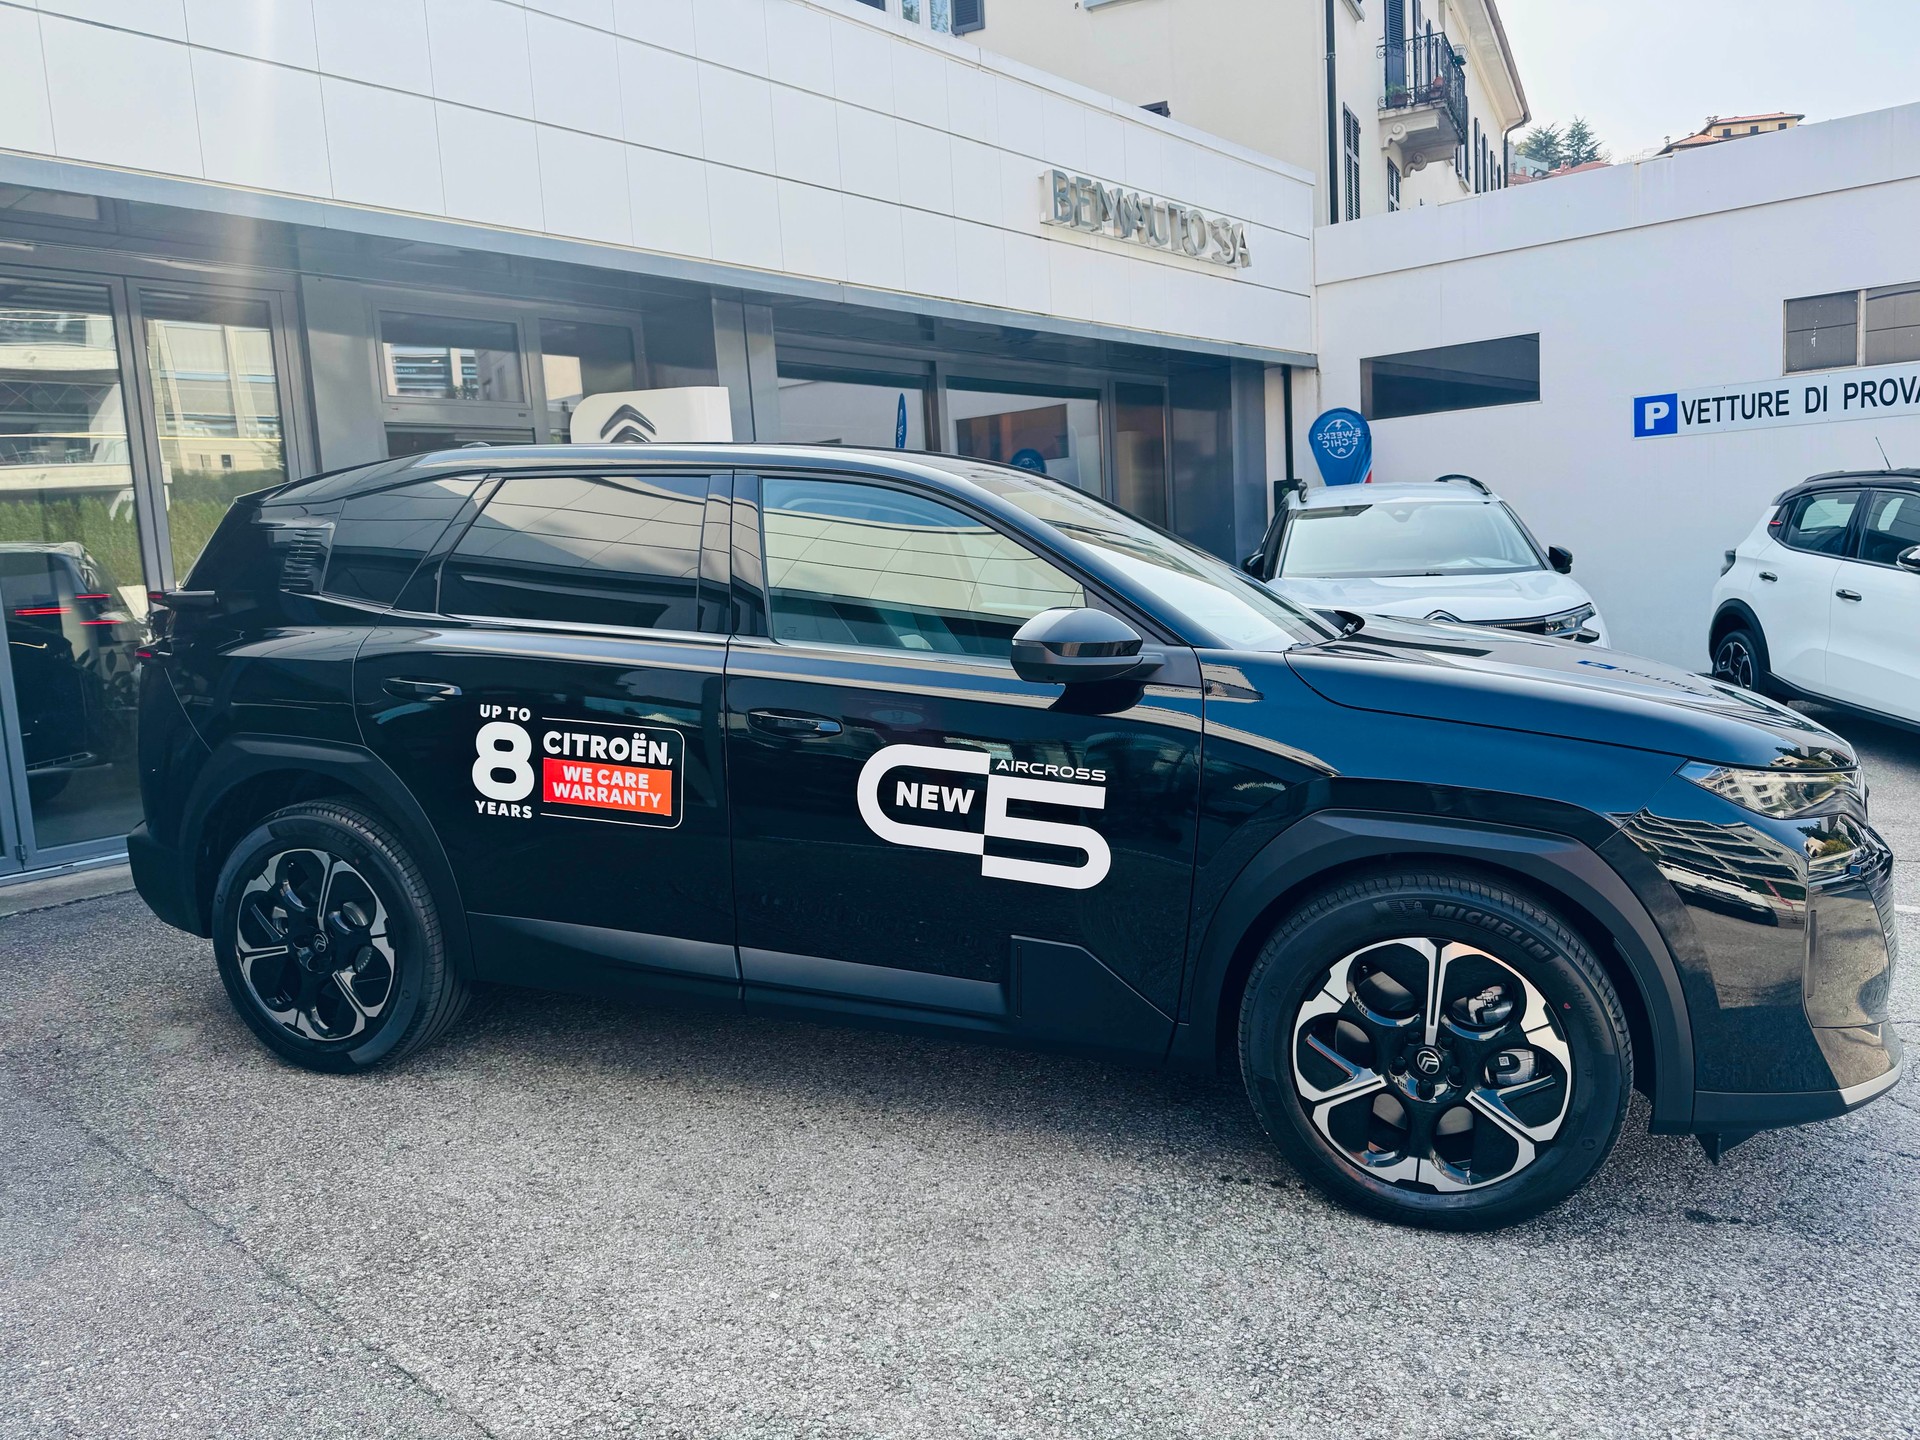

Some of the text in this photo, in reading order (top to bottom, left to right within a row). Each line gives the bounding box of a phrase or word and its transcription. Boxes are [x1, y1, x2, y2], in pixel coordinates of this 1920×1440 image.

[1644, 376, 1920, 431] P VETTURE DI PROV
[479, 703, 532, 722] UP TO
[472, 721, 535, 802] 8
[995, 759, 1107, 782] AIRCROSS
[563, 765, 650, 790] WE CARE
[552, 782, 662, 809] WARRANTY
[895, 781, 976, 815] NEW
[474, 800, 533, 819] YEARS
[1431, 903, 1551, 960] MICHELIN
